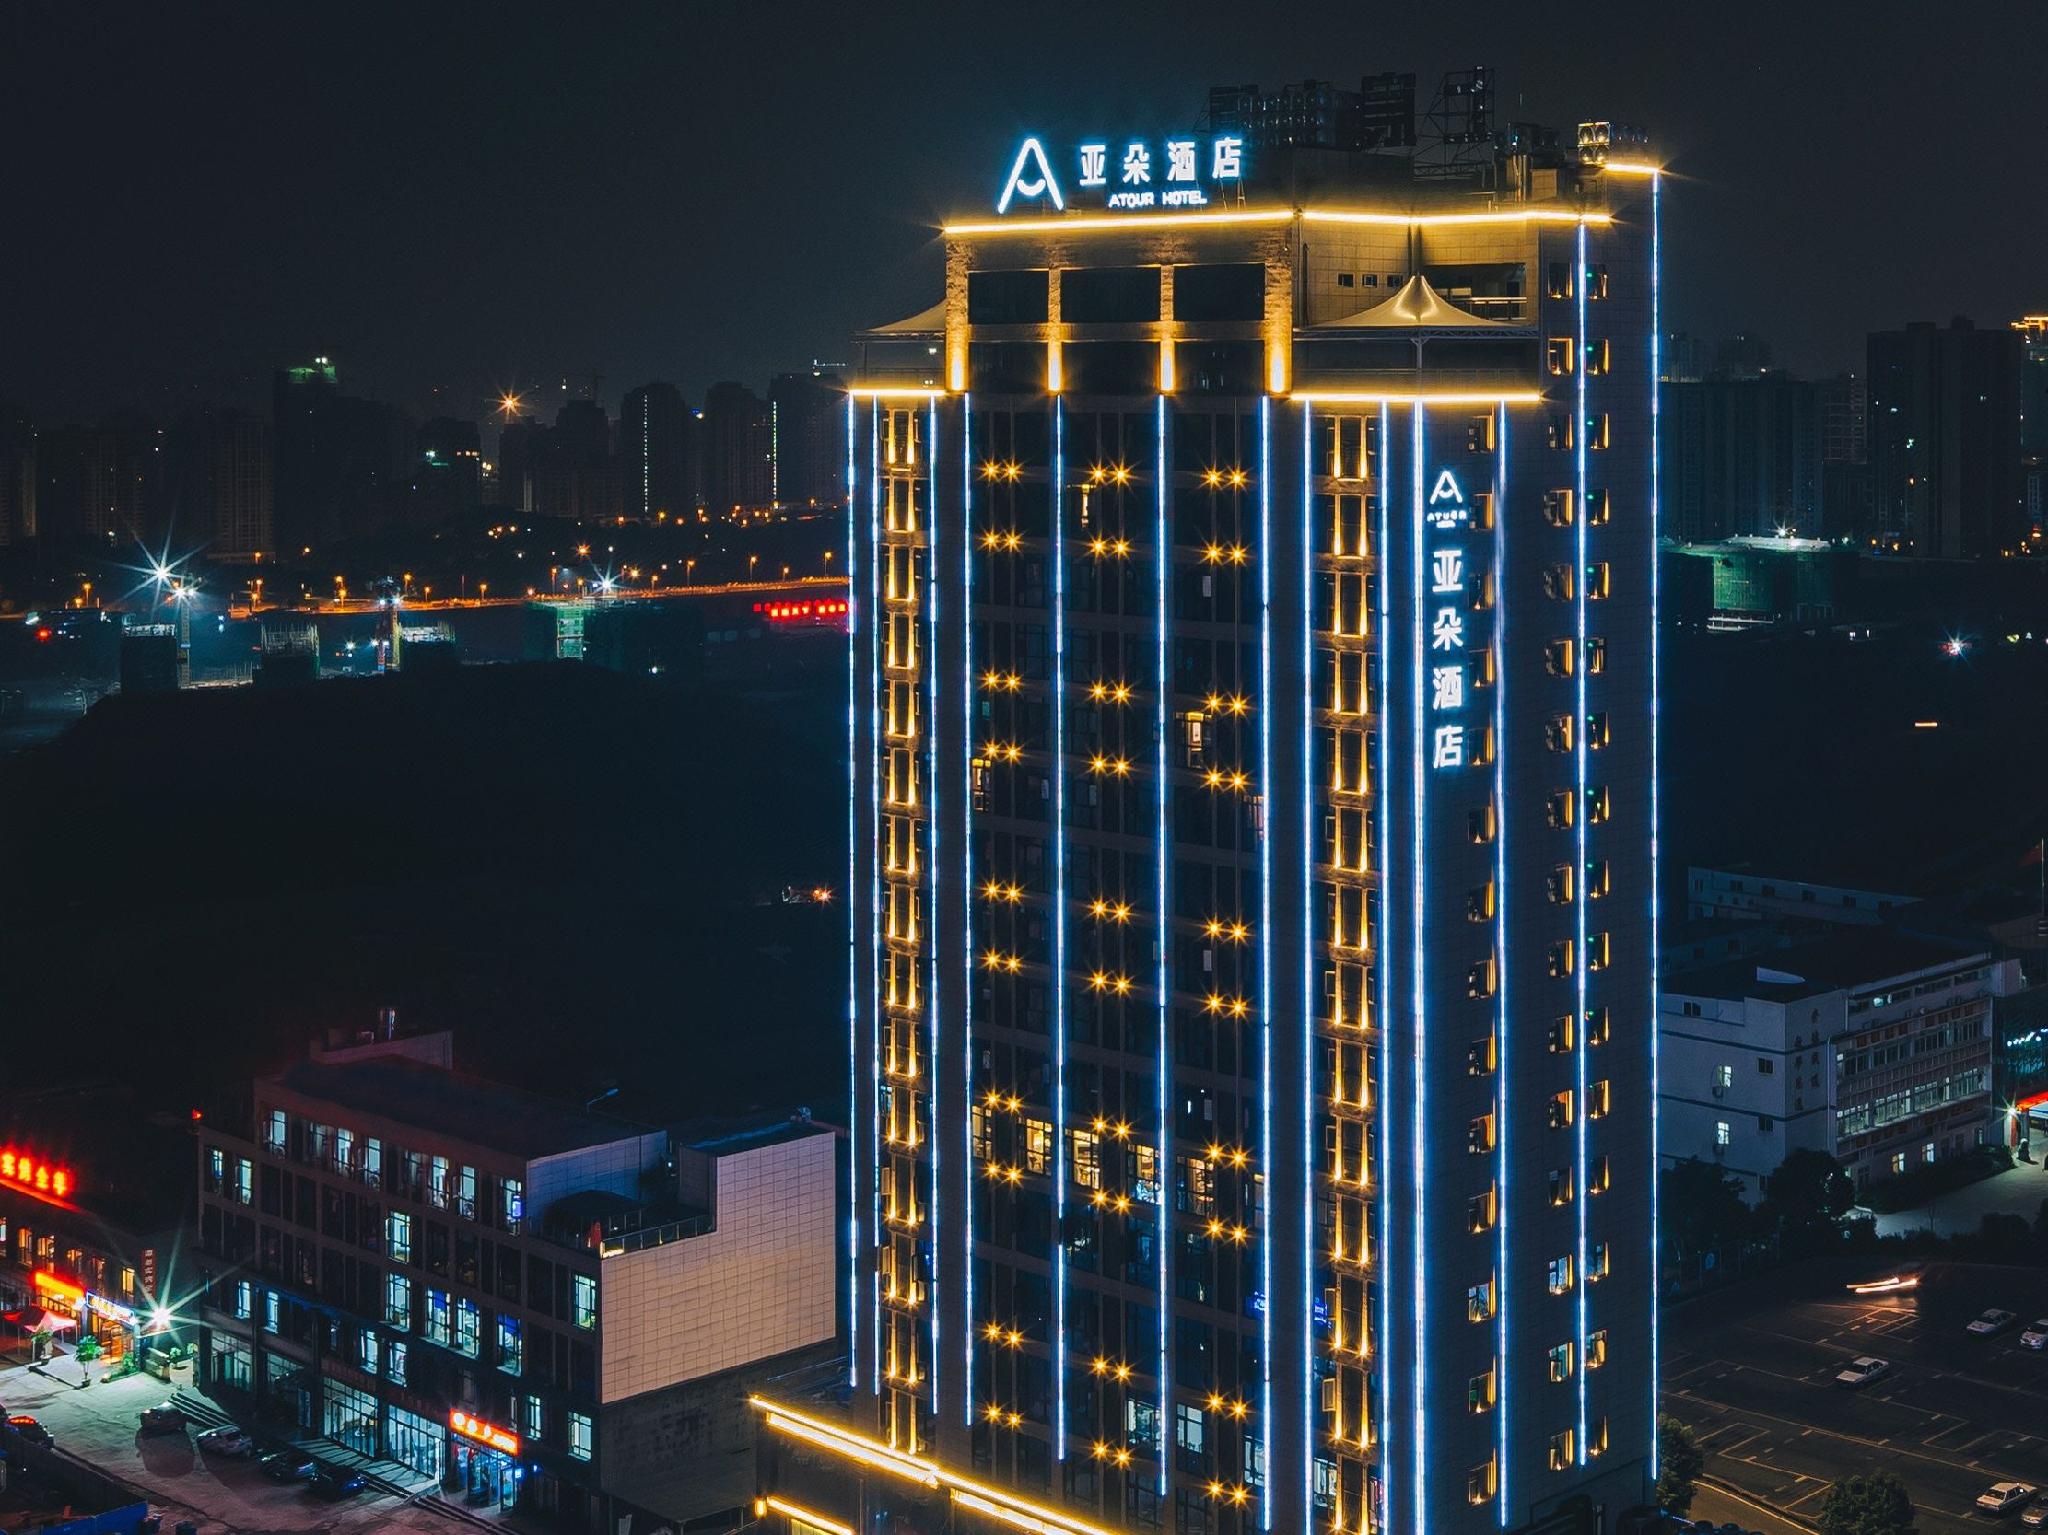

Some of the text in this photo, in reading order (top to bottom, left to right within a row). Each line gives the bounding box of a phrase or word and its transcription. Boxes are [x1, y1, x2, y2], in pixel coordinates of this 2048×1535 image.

[1080, 137, 1242, 186] 亚朵酒店
[1108, 191, 1208, 208] ATOUR HOTEL
[1432, 550, 1463, 769] 亚朵酒店
